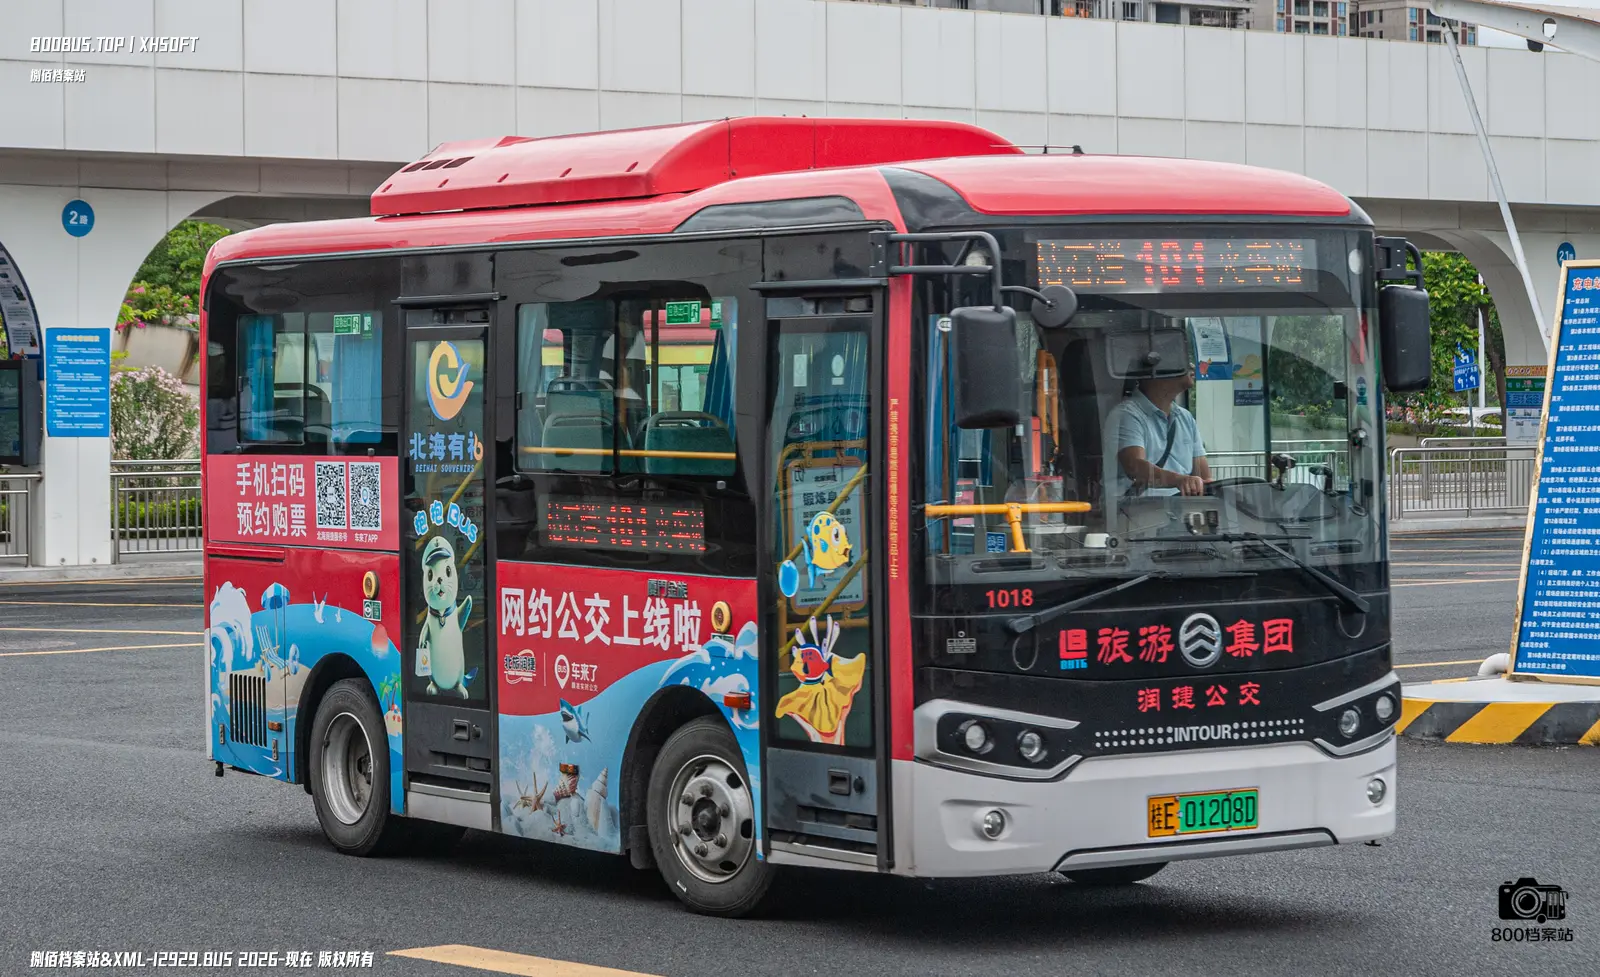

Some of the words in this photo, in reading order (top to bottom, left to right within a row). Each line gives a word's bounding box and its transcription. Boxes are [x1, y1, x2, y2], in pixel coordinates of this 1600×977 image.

[415, 464, 438, 473] BEIHAI
[441, 464, 475, 473] SOUVENIRS
[236, 463, 305, 497] 手机扫码
[236, 502, 307, 538] 预约购票
[985, 588, 1034, 609] 1018
[501, 587, 702, 652] 网约公交上线啦
[557, 664, 568, 674] BUS
[571, 662, 598, 682] 车来了
[1137, 681, 1262, 713] 润捷公交
[1173, 724, 1232, 743] INTOUR
